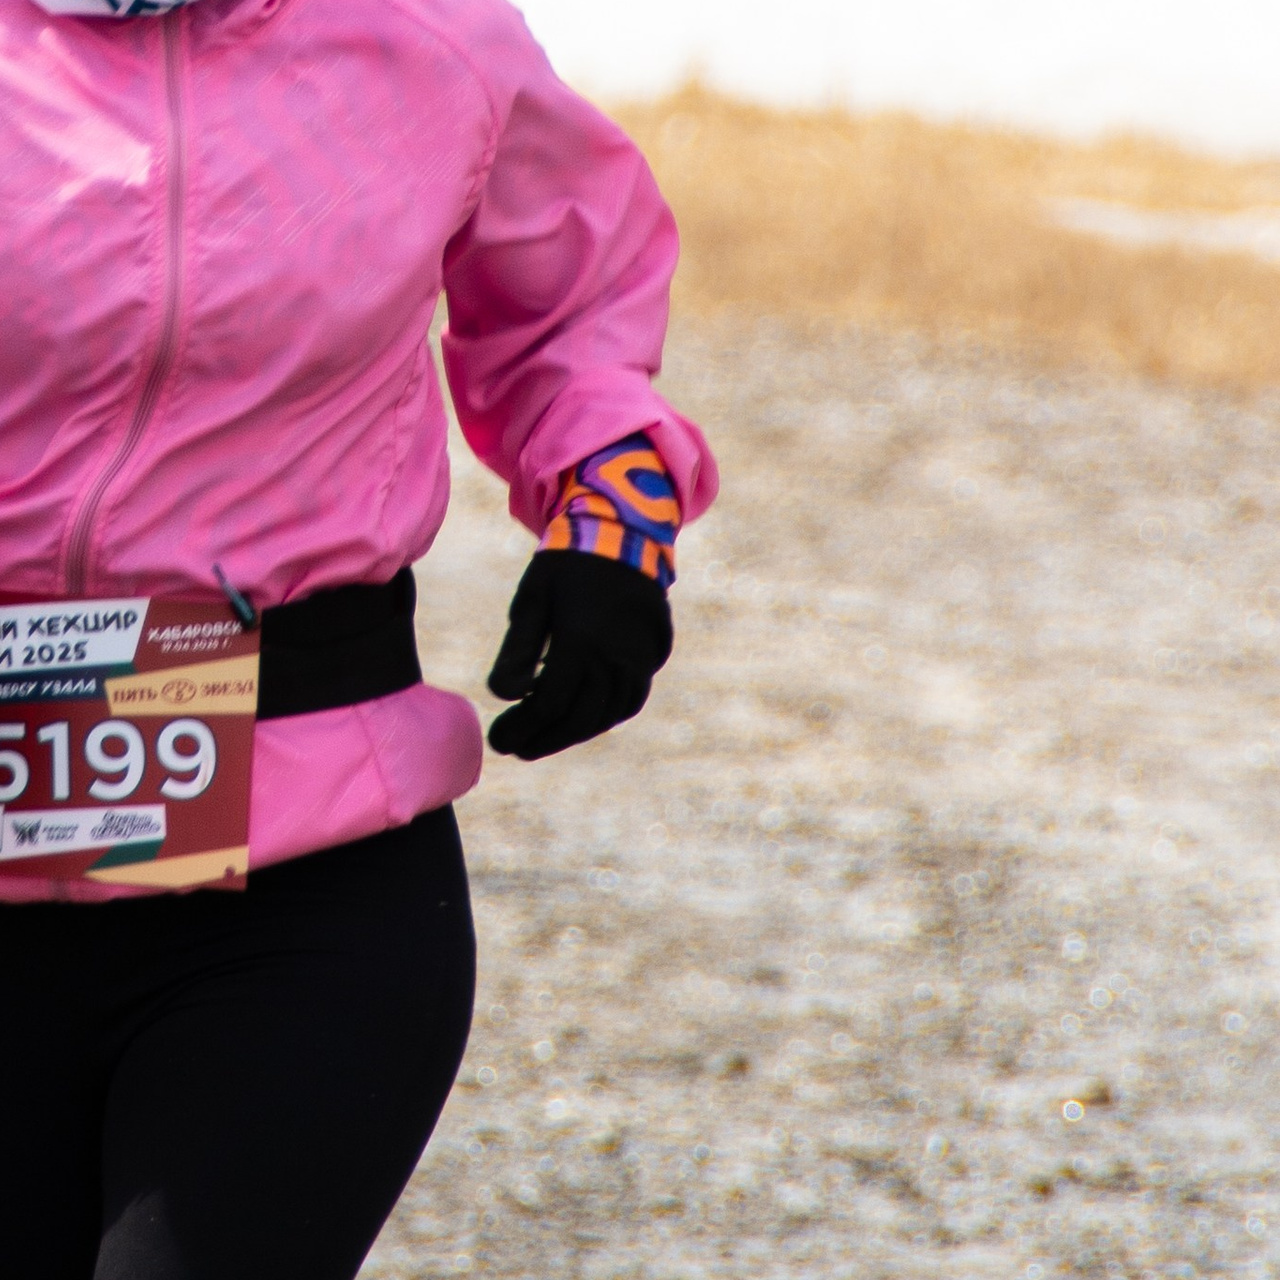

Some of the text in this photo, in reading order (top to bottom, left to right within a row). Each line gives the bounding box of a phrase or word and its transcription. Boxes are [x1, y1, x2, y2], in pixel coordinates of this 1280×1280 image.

[27, 609, 139, 638] ХЕХЦИР
[147, 620, 243, 643] ХАБАРОВСК
[22, 639, 90, 666] 2025
